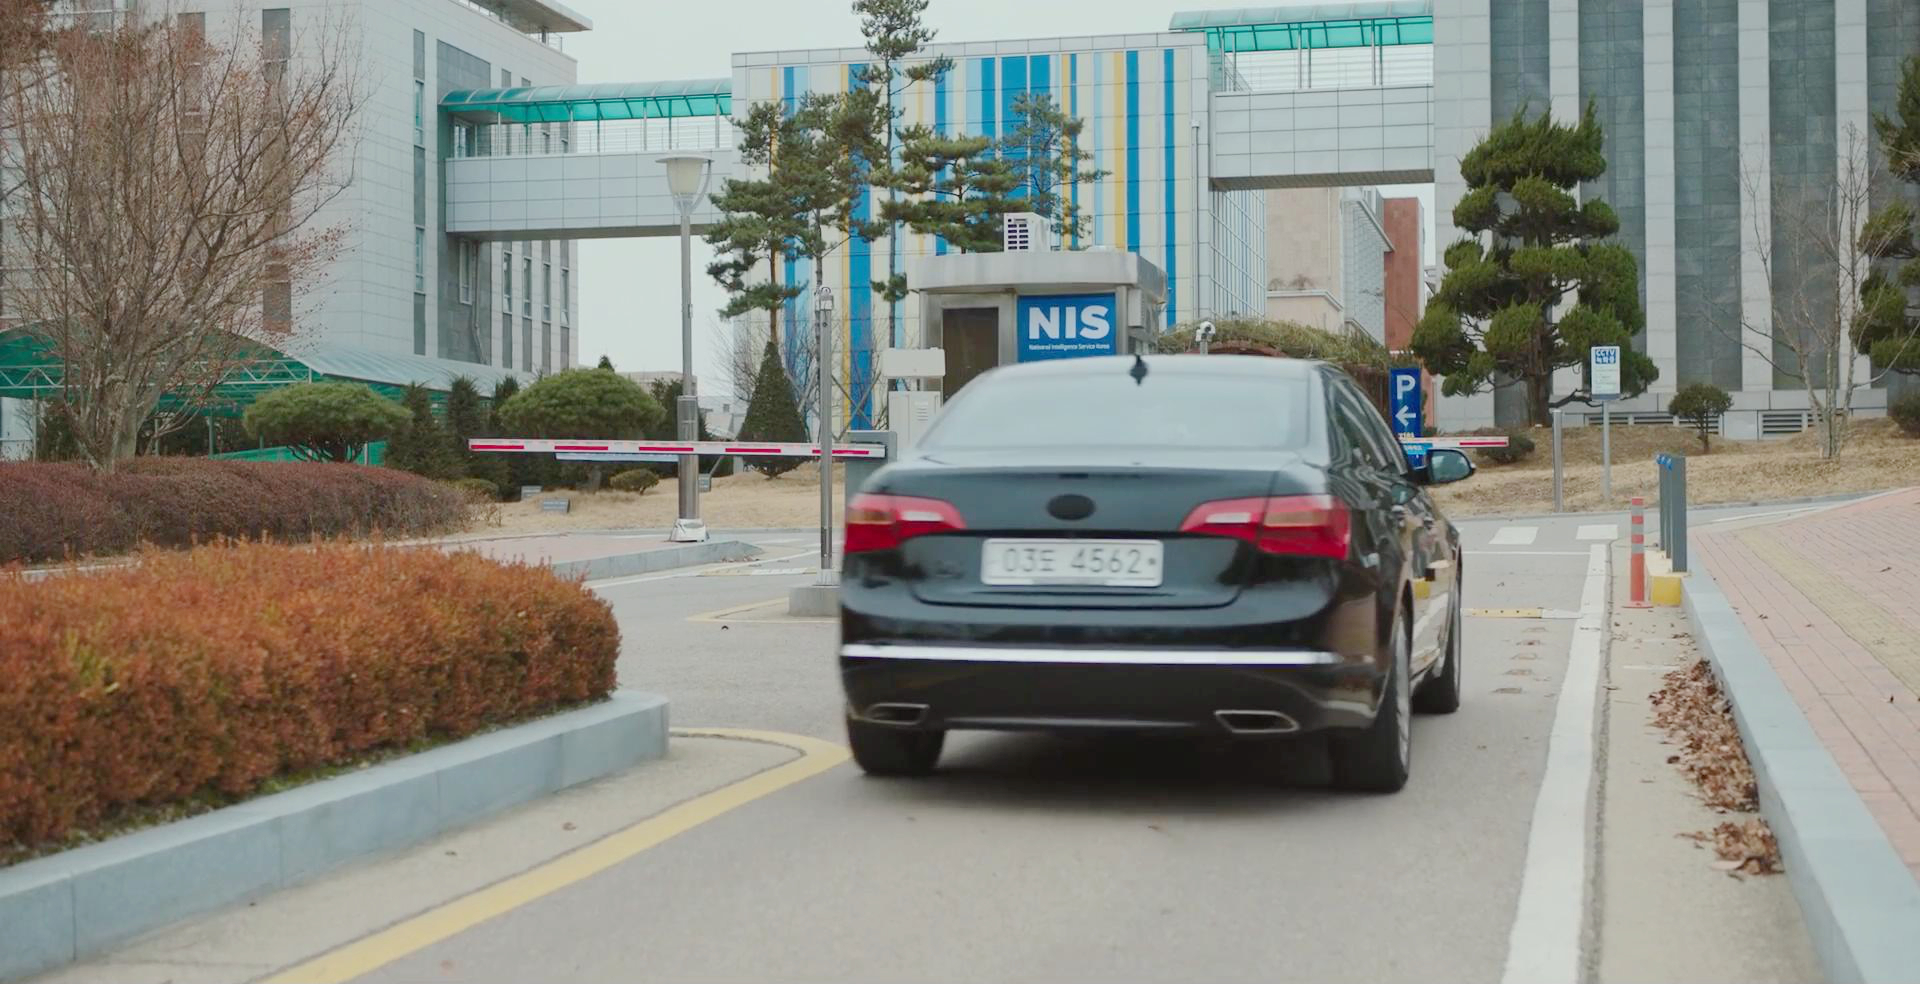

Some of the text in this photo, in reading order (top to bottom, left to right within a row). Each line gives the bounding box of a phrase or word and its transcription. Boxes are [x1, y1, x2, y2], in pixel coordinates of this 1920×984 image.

[1029, 305, 1110, 339] NIS
[1052, 343, 1077, 351] Intelligence
[1596, 348, 1615, 356] CCTV
[1397, 375, 1416, 400] P
[1071, 548, 1142, 574] 4562
